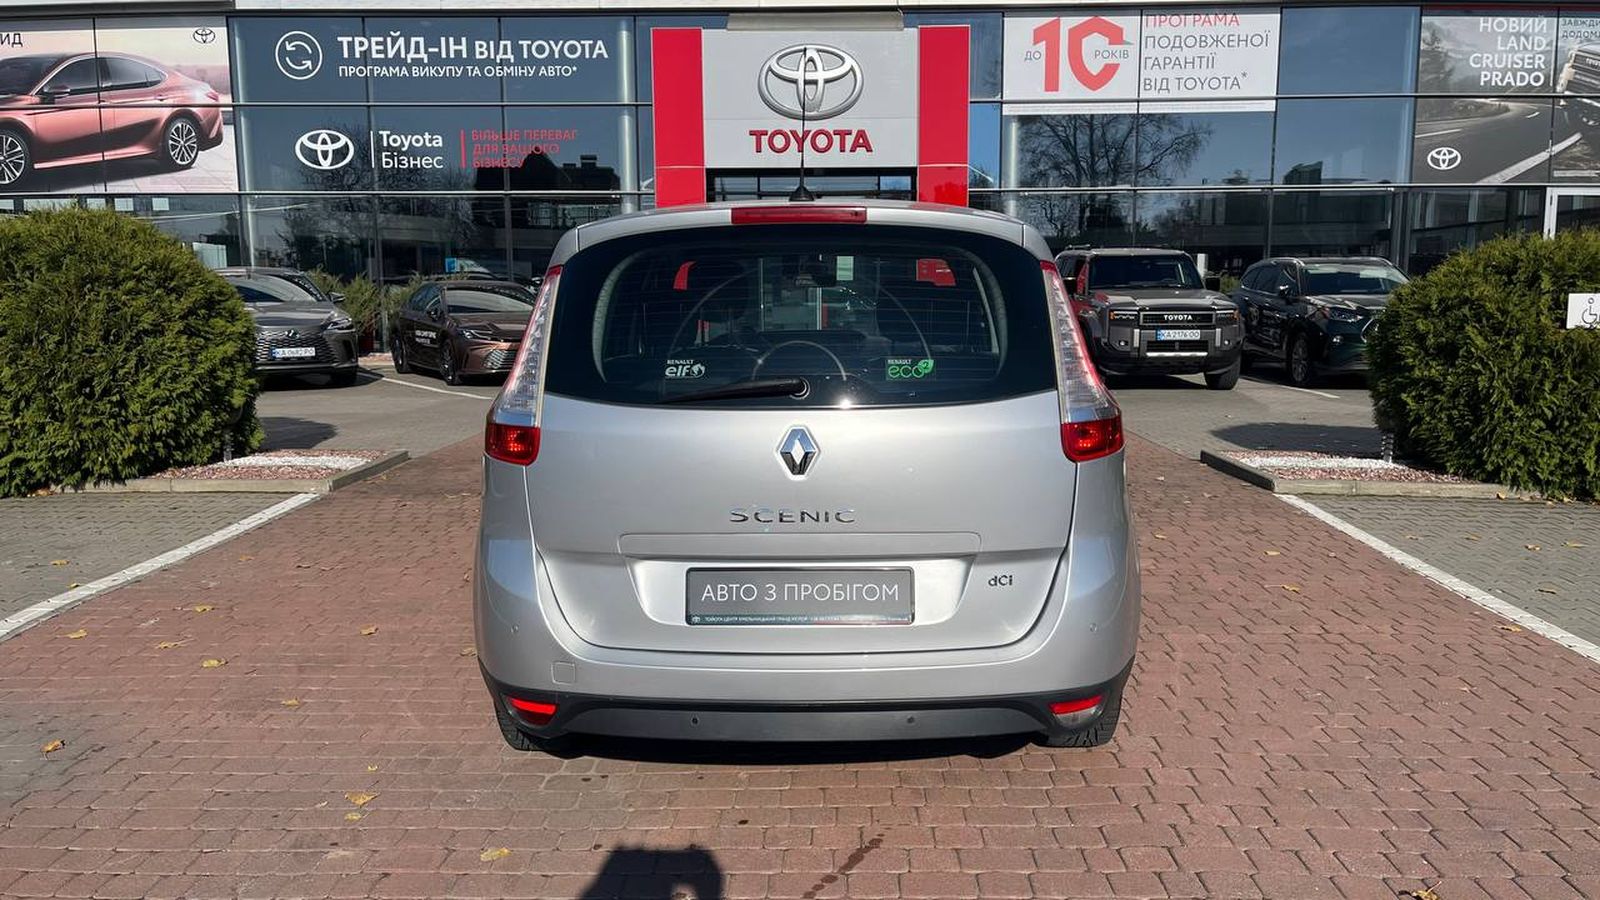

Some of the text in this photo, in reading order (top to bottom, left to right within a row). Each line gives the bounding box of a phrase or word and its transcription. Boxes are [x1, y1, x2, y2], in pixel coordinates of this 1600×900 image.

[1146, 13, 1240, 28] ПРОГРАМА
[337, 31, 609, 63] ТРЕЙД-ІН ВІД TOYOTA
[1145, 30, 1271, 51] ПОДОВЖЕНОЇ
[1497, 36, 1548, 51] LAND
[1024, 51, 1042, 61] ДО
[1094, 50, 1129, 60] РОКІВ
[1144, 52, 1216, 70] ГАРАНТІЇ
[1470, 53, 1546, 69] CRUISER
[339, 66, 409, 77] ПРОГРАМА
[412, 66, 464, 77] ВИКУПУ
[467, 66, 482, 77] ТА
[484, 66, 536, 77] ОБМІНУ
[1480, 71, 1545, 87] PRADO
[1143, 78, 1170, 94] ВІД
[378, 130, 443, 151] Toyota
[472, 129, 577, 141] БІЛЬШЕ ПЕРЕВАГ
[749, 129, 874, 154] TOYOTA
[473, 143, 498, 157] ДЛЯ
[382, 151, 444, 169] Бізнес
[665, 365, 691, 377] elf
[730, 508, 856, 524] SCENIC
[988, 575, 1013, 587] dCi
[702, 584, 758, 602] АВТО
[784, 584, 899, 602] ПРОБІГОМ
